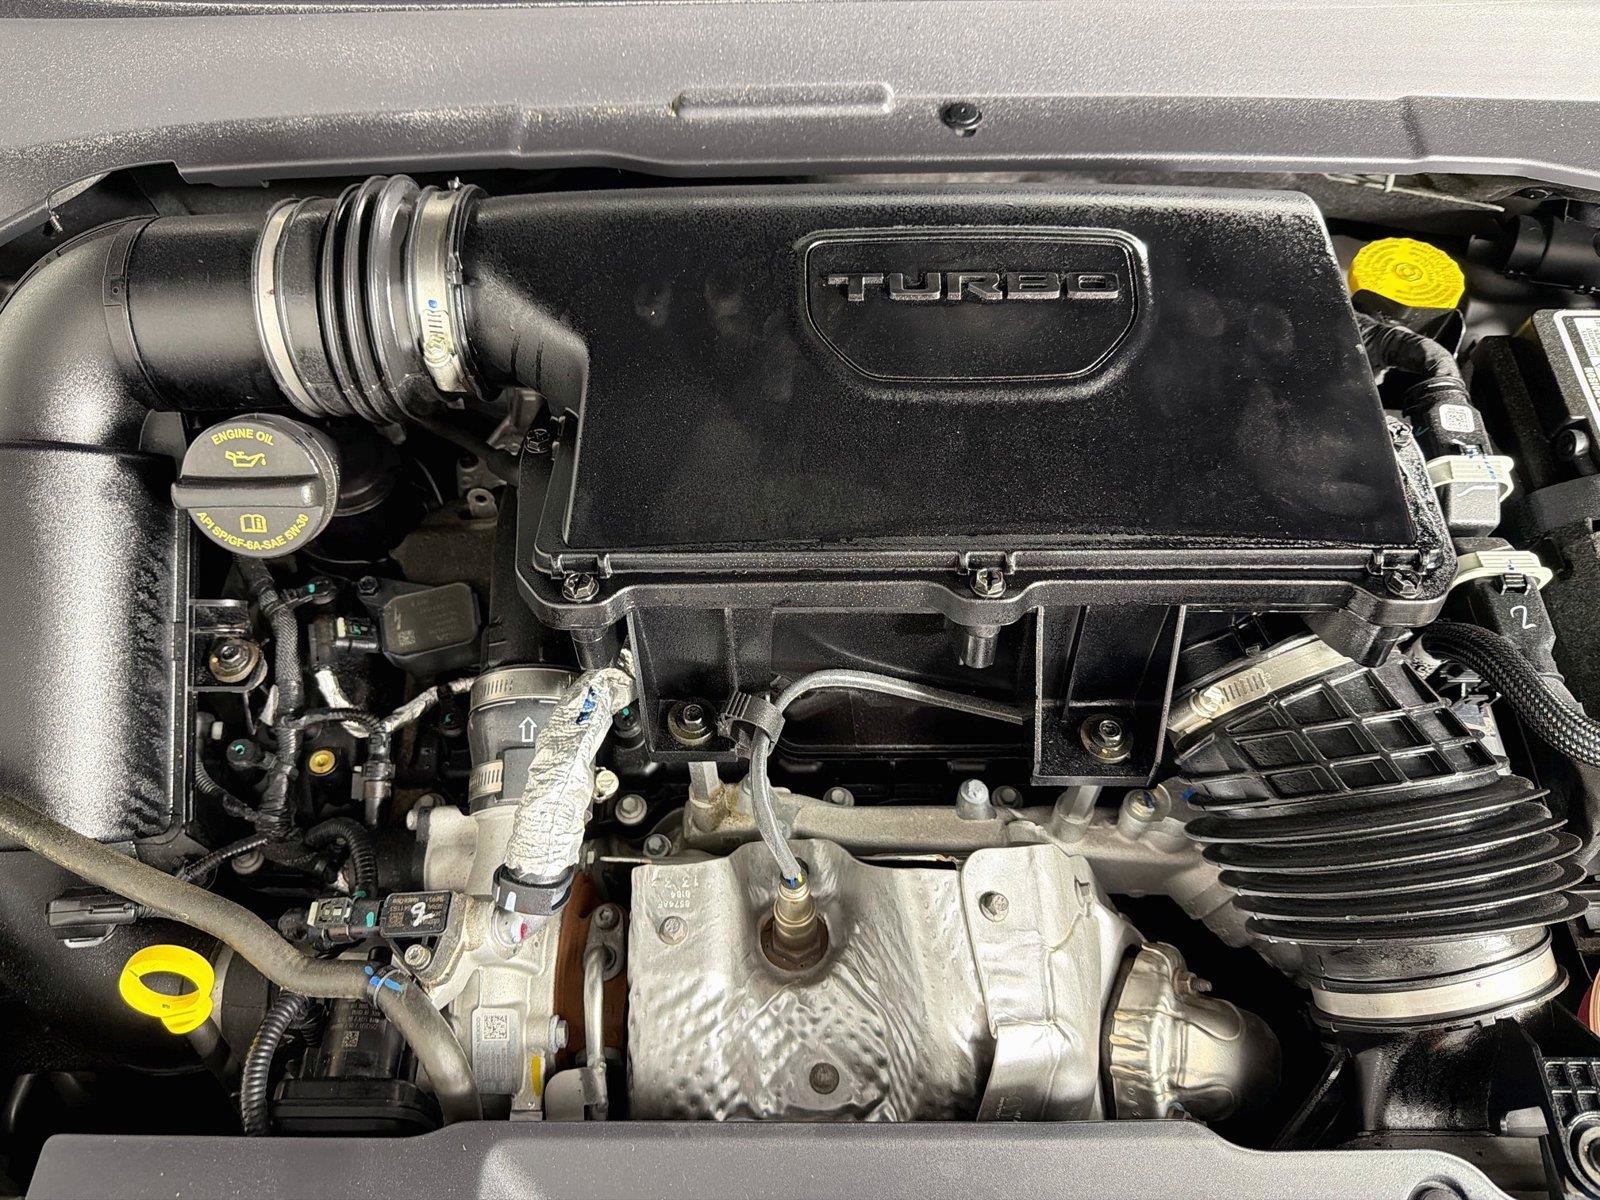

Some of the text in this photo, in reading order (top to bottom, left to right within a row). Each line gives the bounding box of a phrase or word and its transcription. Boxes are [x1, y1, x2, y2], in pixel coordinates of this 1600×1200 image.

[827, 272, 1119, 301] TURBO
[211, 428, 274, 446] ENGINE OIL
[197, 511, 213, 530] API
[285, 513, 309, 541] 5W-30
[1509, 604, 1538, 630] 2
